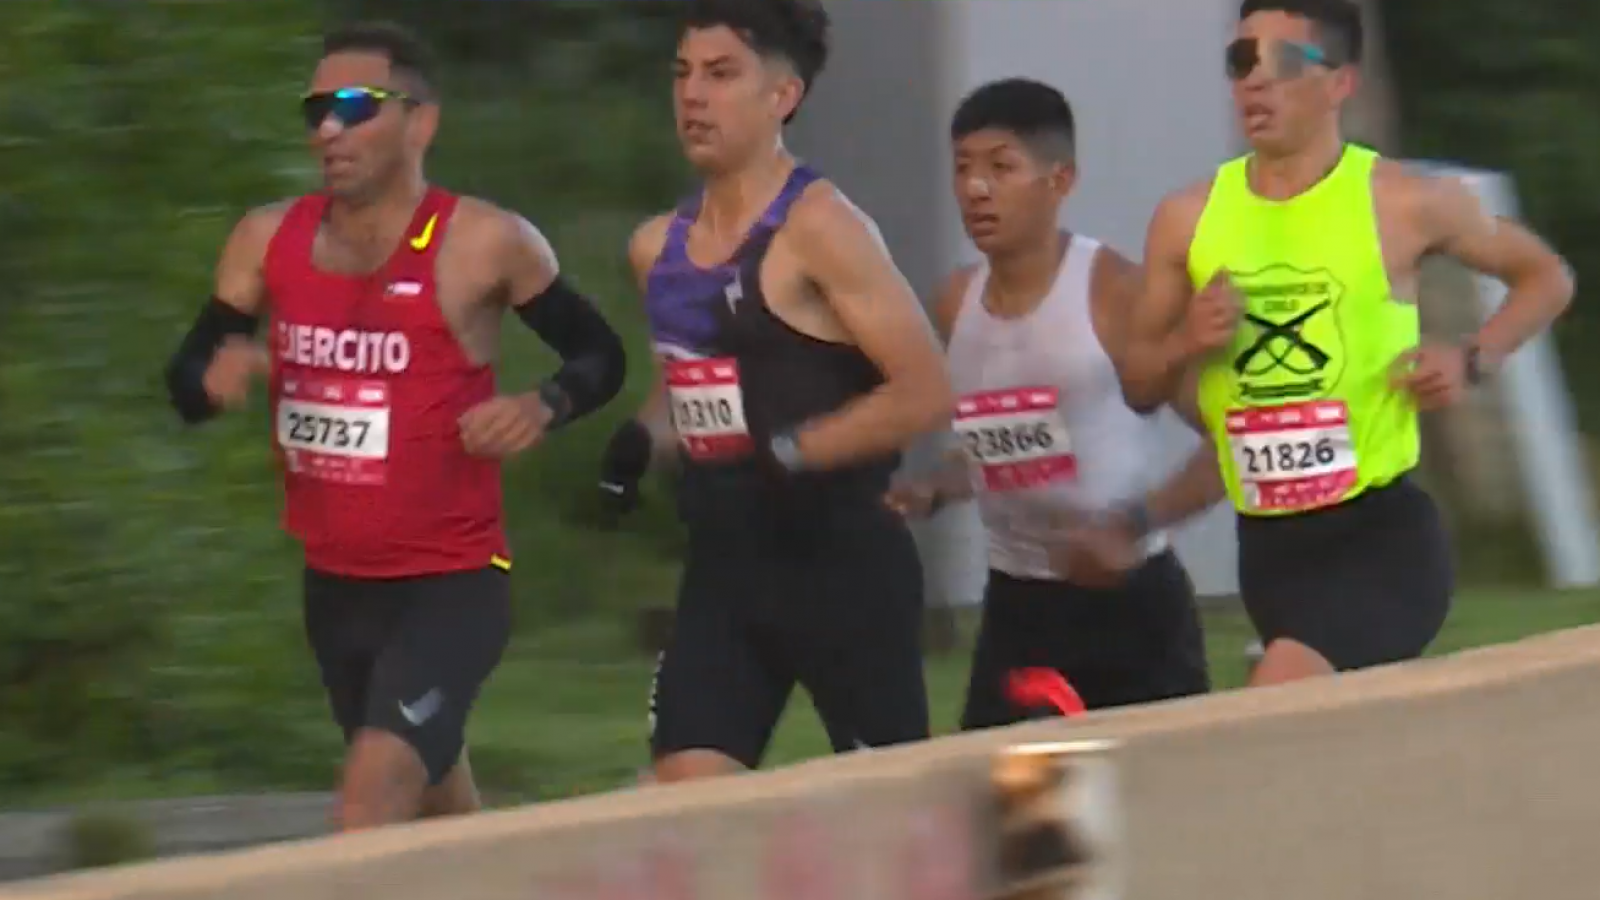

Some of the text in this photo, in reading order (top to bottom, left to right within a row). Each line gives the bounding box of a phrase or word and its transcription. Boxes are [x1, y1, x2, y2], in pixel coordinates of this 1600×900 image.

[288, 412, 371, 448] 25737
[966, 422, 1054, 460] 23866
[1243, 438, 1335, 473] 21826
